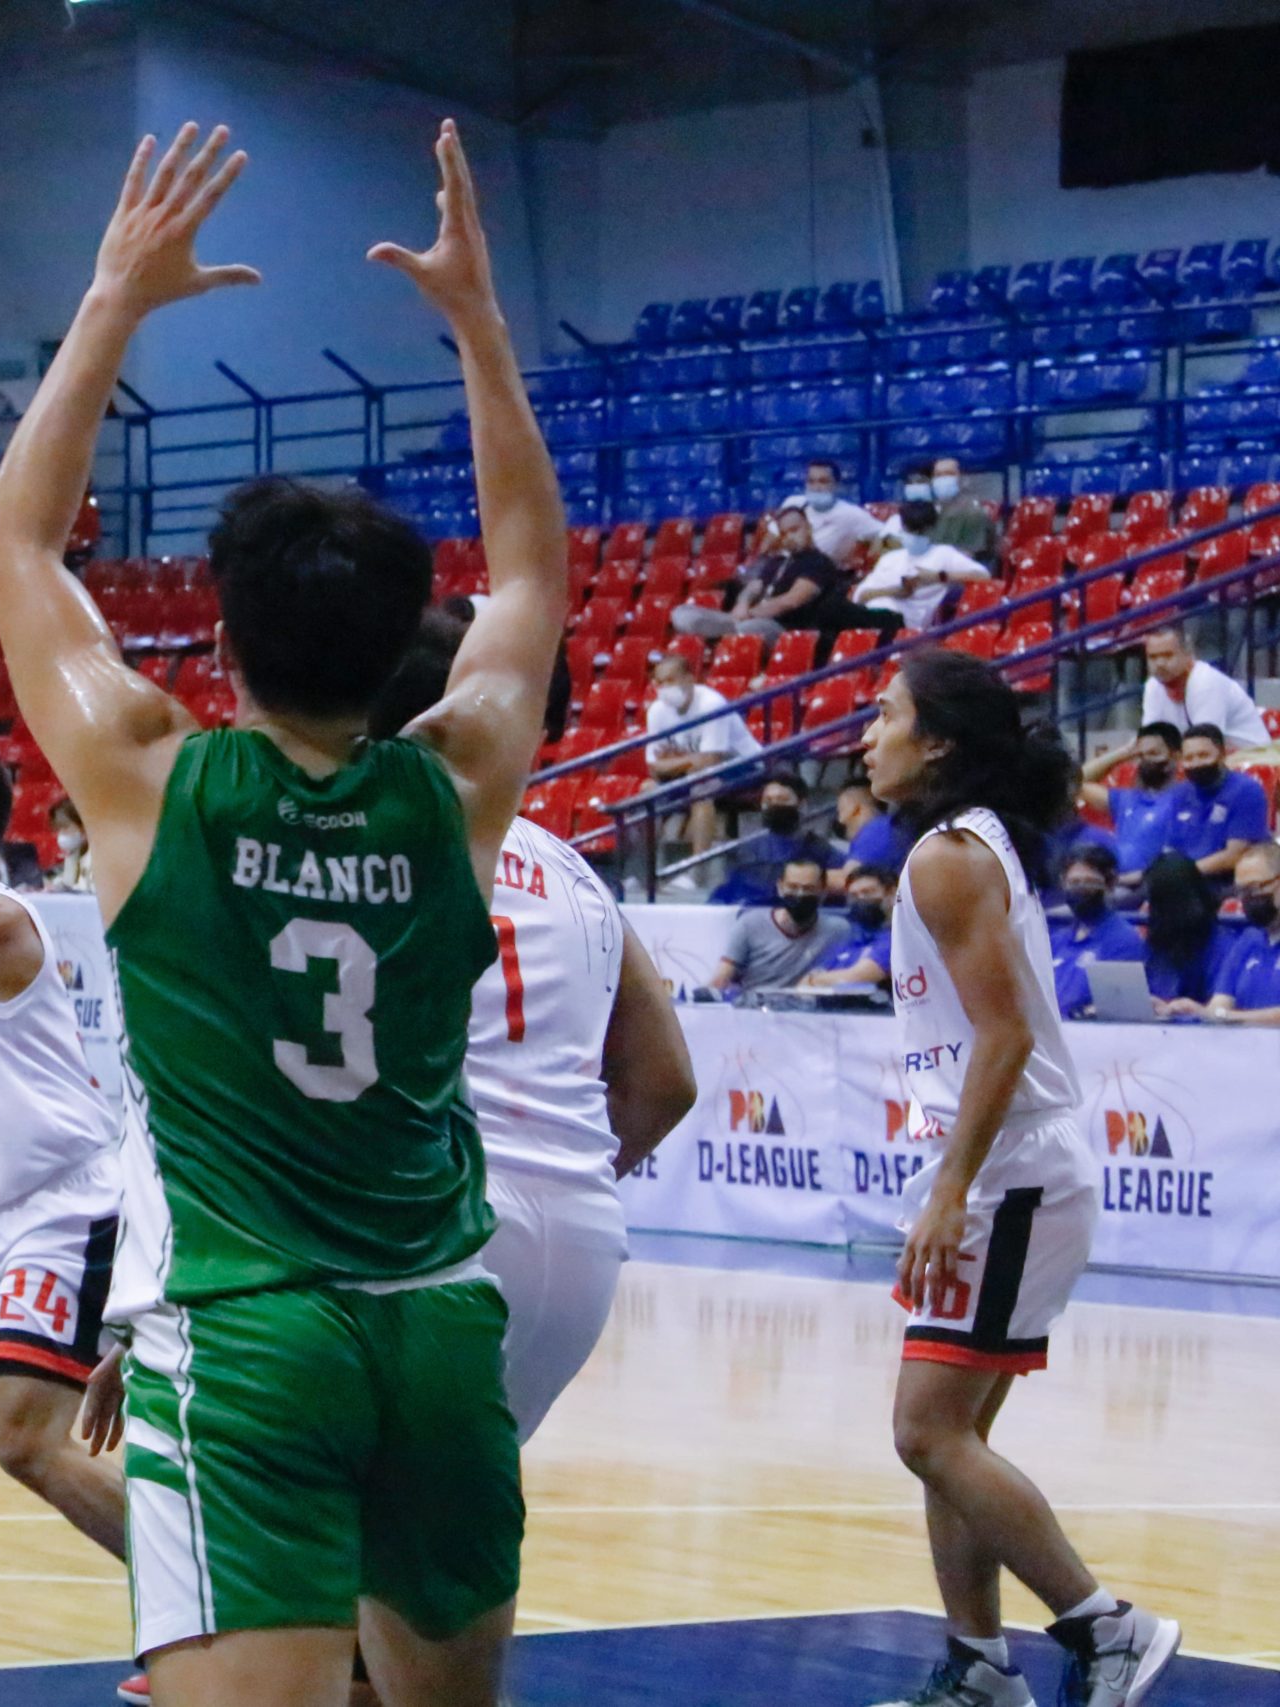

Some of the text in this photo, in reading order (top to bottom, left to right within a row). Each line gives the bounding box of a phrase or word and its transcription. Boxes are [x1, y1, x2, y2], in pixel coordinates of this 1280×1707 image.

[232, 836, 413, 905] BLANCO
[269, 916, 380, 1103] 3
[728, 1089, 786, 1136] PBA
[1104, 1109, 1173, 1159] PBA
[697, 1139, 822, 1191] D-LEAGUE
[1103, 1165, 1213, 1218] LEAGUE
[0, 1267, 71, 1334] 24
